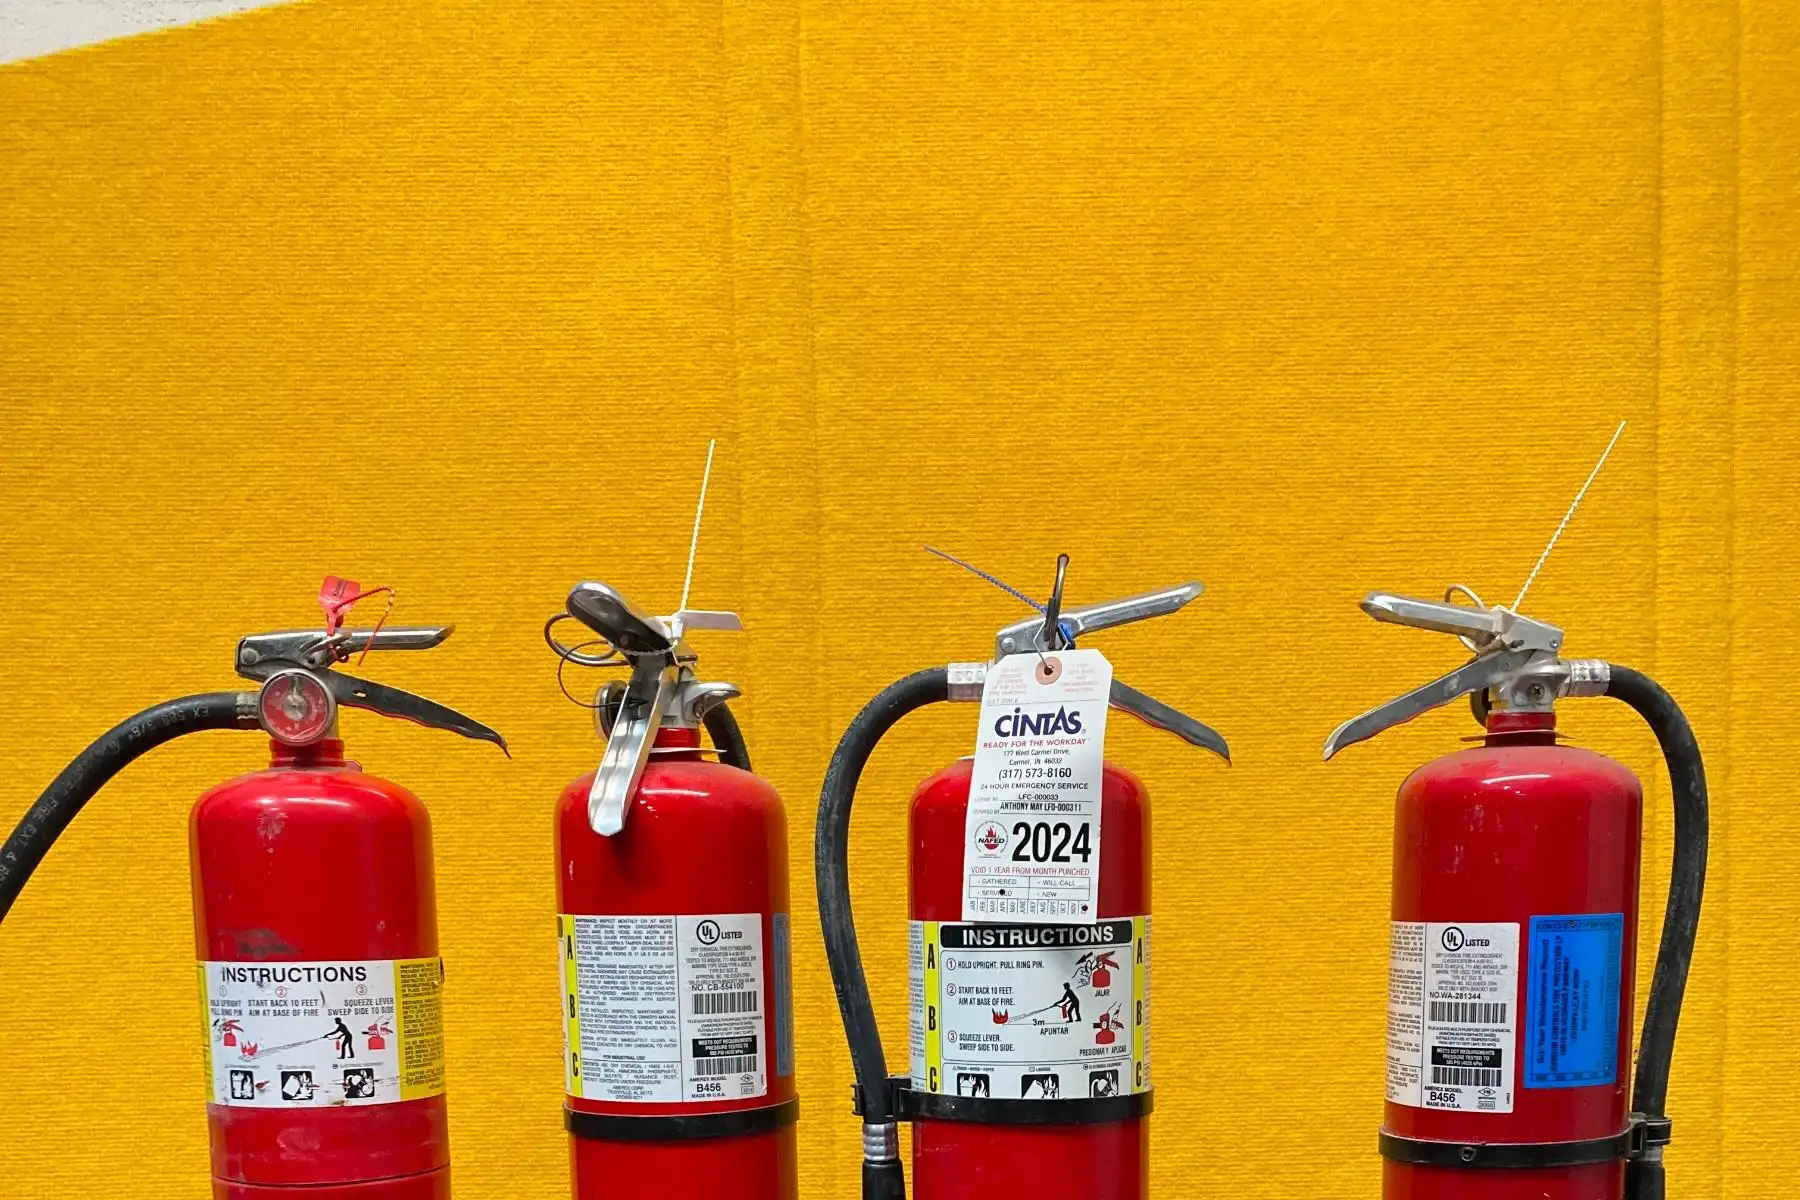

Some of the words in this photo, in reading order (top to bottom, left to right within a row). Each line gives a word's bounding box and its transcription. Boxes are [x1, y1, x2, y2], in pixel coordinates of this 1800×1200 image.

[983, 741, 1009, 749] READY
[1011, 740, 1027, 748] FOR
[1029, 739, 1044, 747] THE
[1046, 738, 1087, 746] WORKDAY
[1053, 748, 1071, 756] Drive,
[998, 768, 1023, 780] (317)
[1025, 767, 1072, 778] 573-8160
[1011, 782, 1056, 790] EMERGENCY
[1057, 782, 1089, 790] SERVICE
[1000, 801, 1028, 811] ANTHONY
[1029, 802, 1043, 811] MAY
[1011, 821, 1092, 863] 2024
[971, 866, 987, 874] VOID
[1012, 867, 1031, 875] FROM
[1058, 868, 1090, 876] PUNCHED
[721, 931, 743, 940] LISTED
[962, 925, 1114, 946] INSTRUCTIONS
[567, 934, 573, 960] A
[1465, 938, 1490, 947] LISTED
[1136, 937, 1143, 965] A
[927, 943, 936, 970] A
[957, 960, 972, 969] HOLD
[1000, 960, 1015, 969] PULL
[1016, 960, 1031, 969] RING
[1032, 960, 1045, 969] PIN.
[222, 966, 367, 983] INSTRUCTIONS
[958, 986, 975, 995] START
[975, 986, 990, 995] BACK
[991, 986, 998, 995] 10
[999, 986, 1014, 995] FEET.
[1094, 989, 1110, 997] JALAR
[248, 999, 268, 1007] START
[270, 999, 288, 1007] BACK
[301, 998, 319, 1007] FEET
[344, 998, 374, 1007] SQUEEZE
[375, 997, 394, 1006] LEVER
[569, 994, 576, 1019] B
[958, 997, 969, 1006] AIM
[969, 997, 976, 1006] AT
[976, 997, 991, 1006] BASE
[991, 997, 1000, 1006] OF
[1000, 997, 1016, 1006] FIRE.
[248, 1009, 260, 1017] AIM
[262, 1009, 271, 1017] AT
[272, 1009, 290, 1017] BASE
[292, 1009, 301, 1017] OF
[303, 1008, 320, 1017] FIRE
[327, 1008, 352, 1016] SWEEP
[354, 1007, 369, 1015] SIDE
[381, 1006, 394, 1014] SIDE
[1136, 1000, 1142, 1026] B
[928, 1005, 936, 1031] B
[1032, 1018, 1045, 1026] 3m
[1040, 1027, 1069, 1036] APUNTAR
[959, 1033, 982, 1042] SQUEEZE
[982, 1033, 1002, 1042] LEVER.
[959, 1043, 977, 1052] SWEEP
[977, 1043, 991, 1052] SIDE
[991, 1043, 999, 1052] TO
[999, 1043, 1015, 1052] SIDE.
[1079, 1047, 1105, 1056] PRESIONAR
[1111, 1045, 1127, 1054] APLICAR
[572, 1052, 579, 1077] C
[1135, 1060, 1142, 1088] C
[929, 1066, 937, 1093] C
[696, 1082, 722, 1093] B456
[1430, 1092, 1456, 1103] B456
